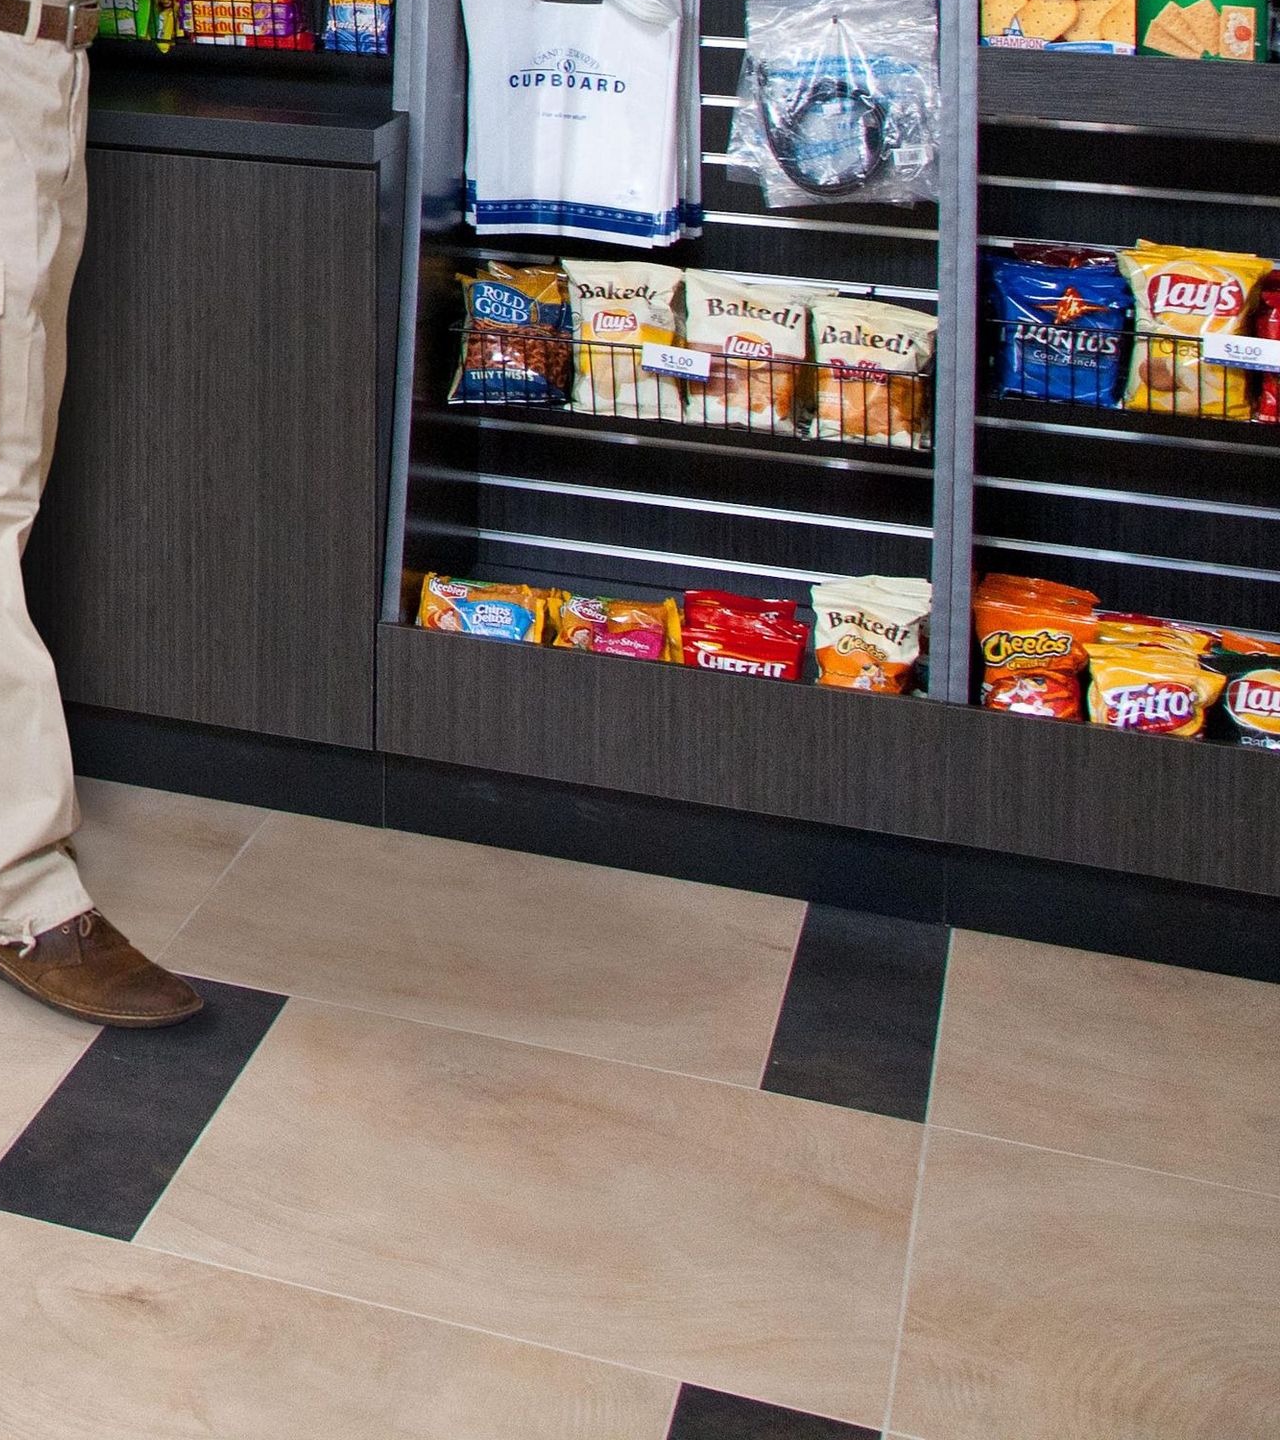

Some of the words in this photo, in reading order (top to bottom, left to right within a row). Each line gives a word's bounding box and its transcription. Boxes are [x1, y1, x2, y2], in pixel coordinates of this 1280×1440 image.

[989, 36, 1044, 50] CHAMPION
[508, 73, 627, 94] CUPBOARD
[482, 285, 526, 311] ROLD
[474, 297, 529, 323] GOLD
[704, 298, 802, 330] Baked!
[819, 325, 915, 356] Baked!
[1223, 343, 1263, 357] $1.00
[660, 353, 694, 367] $1.00
[472, 613, 514, 625] Deluxe
[475, 603, 511, 616] Chips
[826, 610, 912, 647] Baked!
[983, 631, 1073, 664] Cheetos
